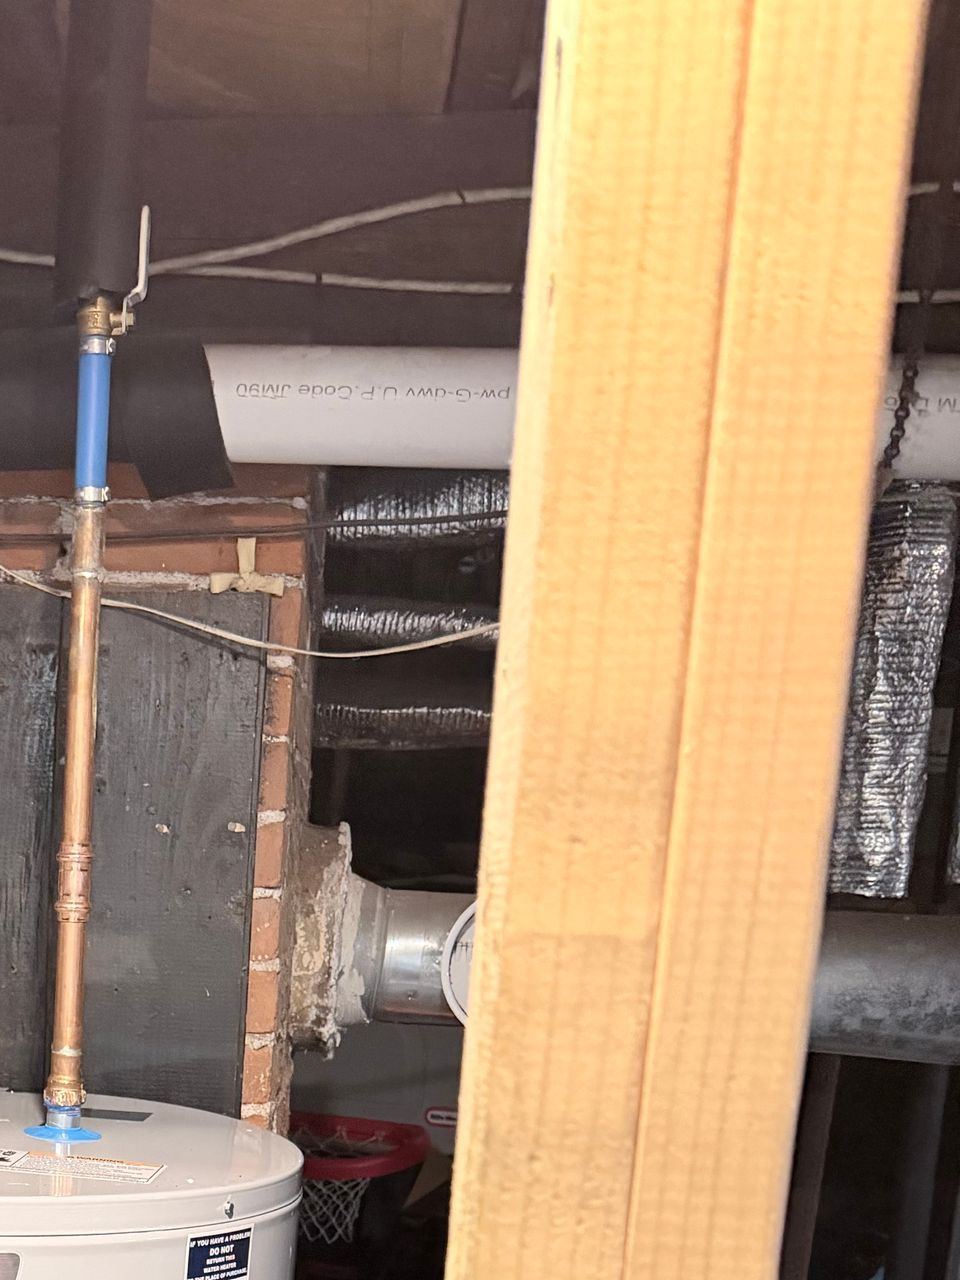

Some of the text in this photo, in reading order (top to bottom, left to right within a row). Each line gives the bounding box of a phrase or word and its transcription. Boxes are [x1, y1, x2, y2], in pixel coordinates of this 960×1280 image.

[197, 1239, 209, 1247] YOU
[209, 1236, 224, 1245] HAVE
[209, 1244, 235, 1256] DO NOT
[203, 1265, 219, 1274] WATER
